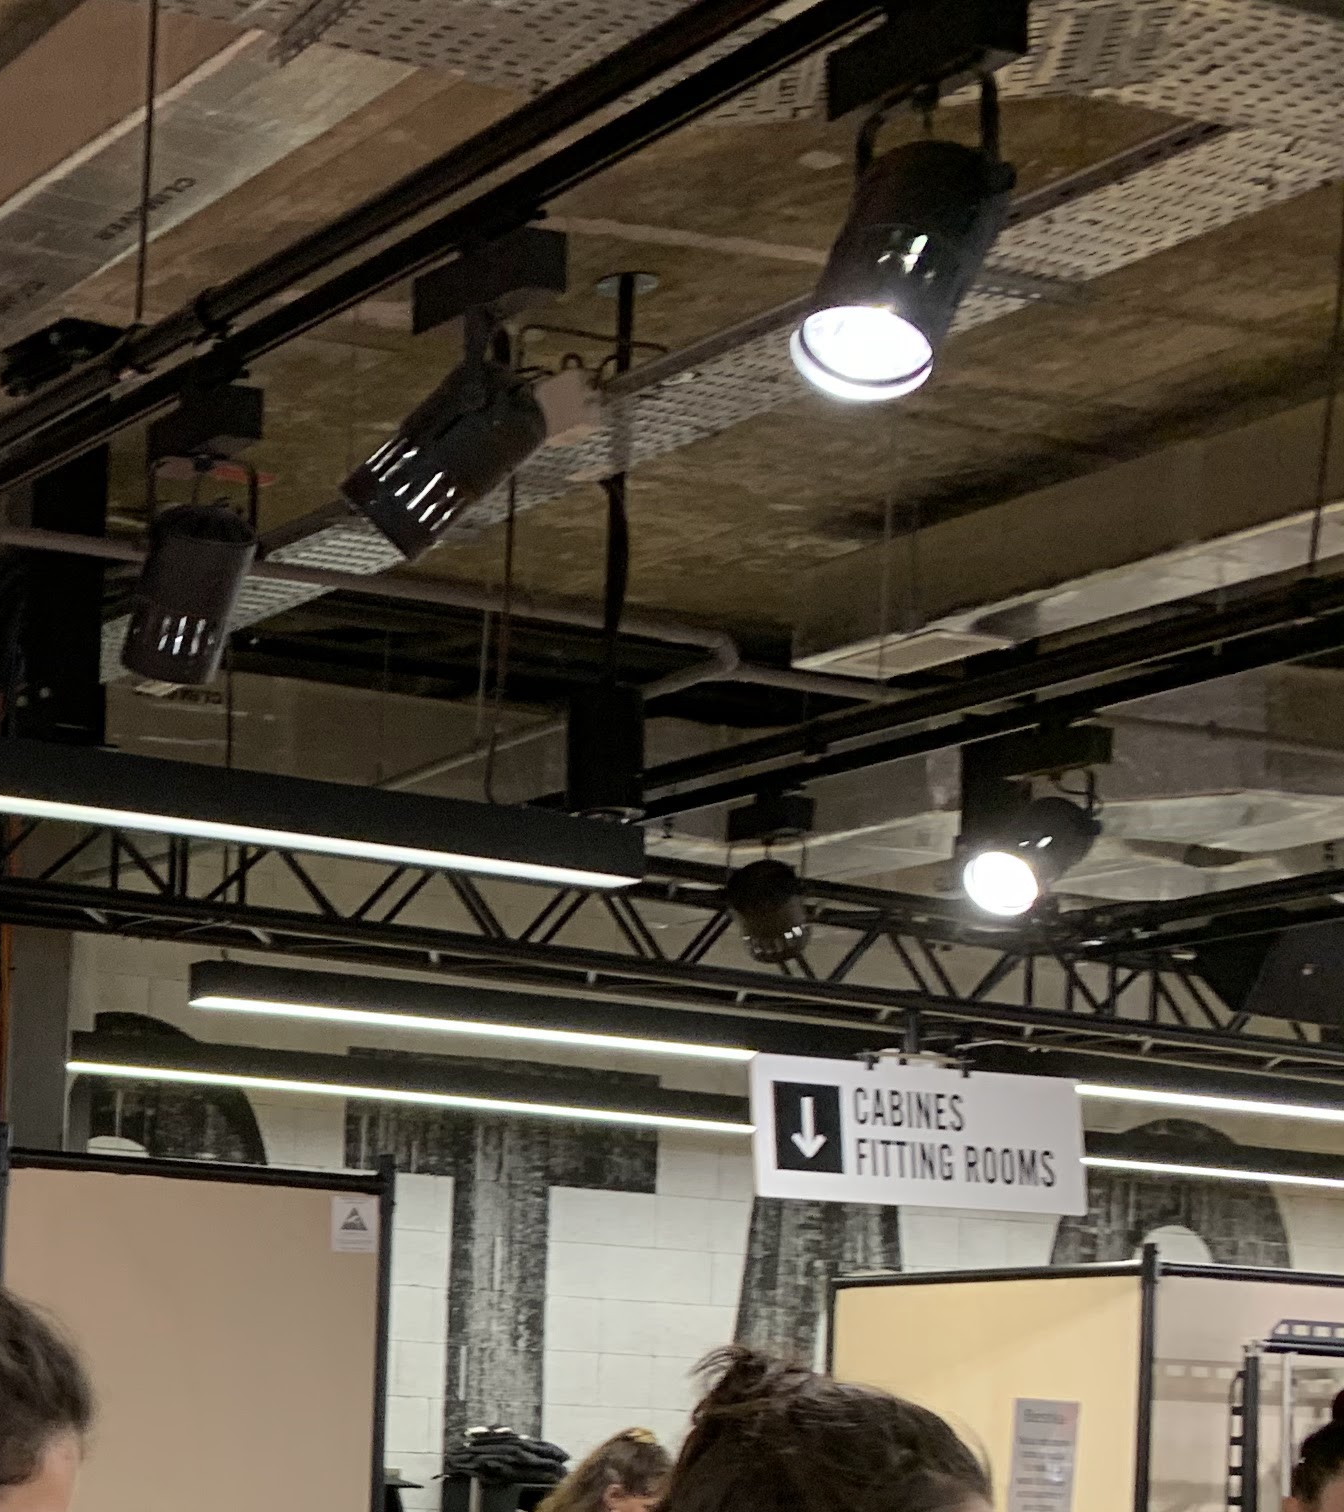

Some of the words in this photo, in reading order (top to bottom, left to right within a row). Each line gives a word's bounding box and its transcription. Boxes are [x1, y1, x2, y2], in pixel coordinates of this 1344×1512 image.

[853, 1086, 964, 1132] CABINES
[856, 1137, 955, 1181] FITTING
[965, 1146, 1056, 1188] ROOMS
